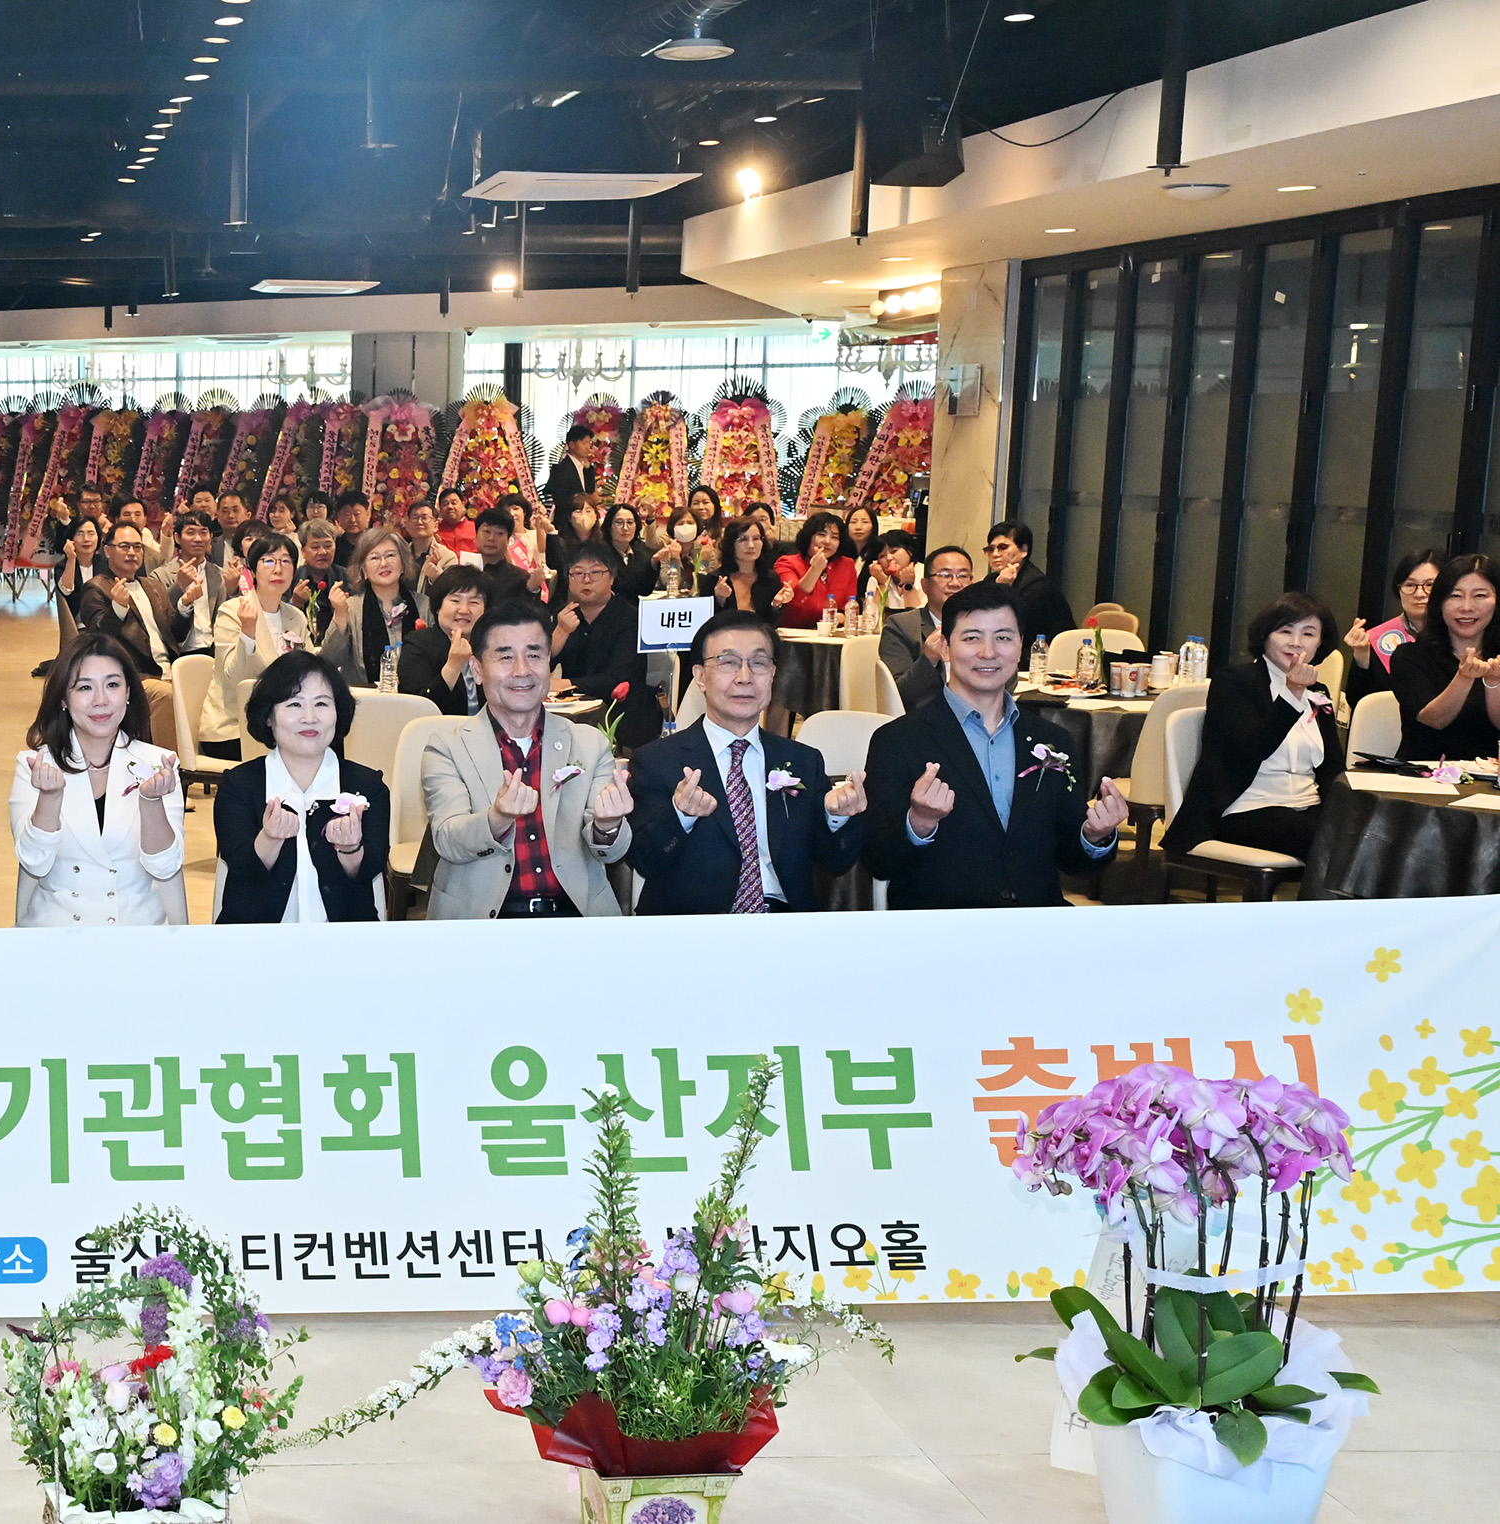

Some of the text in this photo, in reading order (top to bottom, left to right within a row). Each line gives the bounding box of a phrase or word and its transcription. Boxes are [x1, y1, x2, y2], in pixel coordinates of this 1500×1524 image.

[660, 610, 693, 629] 내빈
[467, 1044, 934, 1177] 울산지부
[69, 1228, 547, 1286] 울산티컨벤션센터
[666, 1219, 929, 1275] 지오홀
